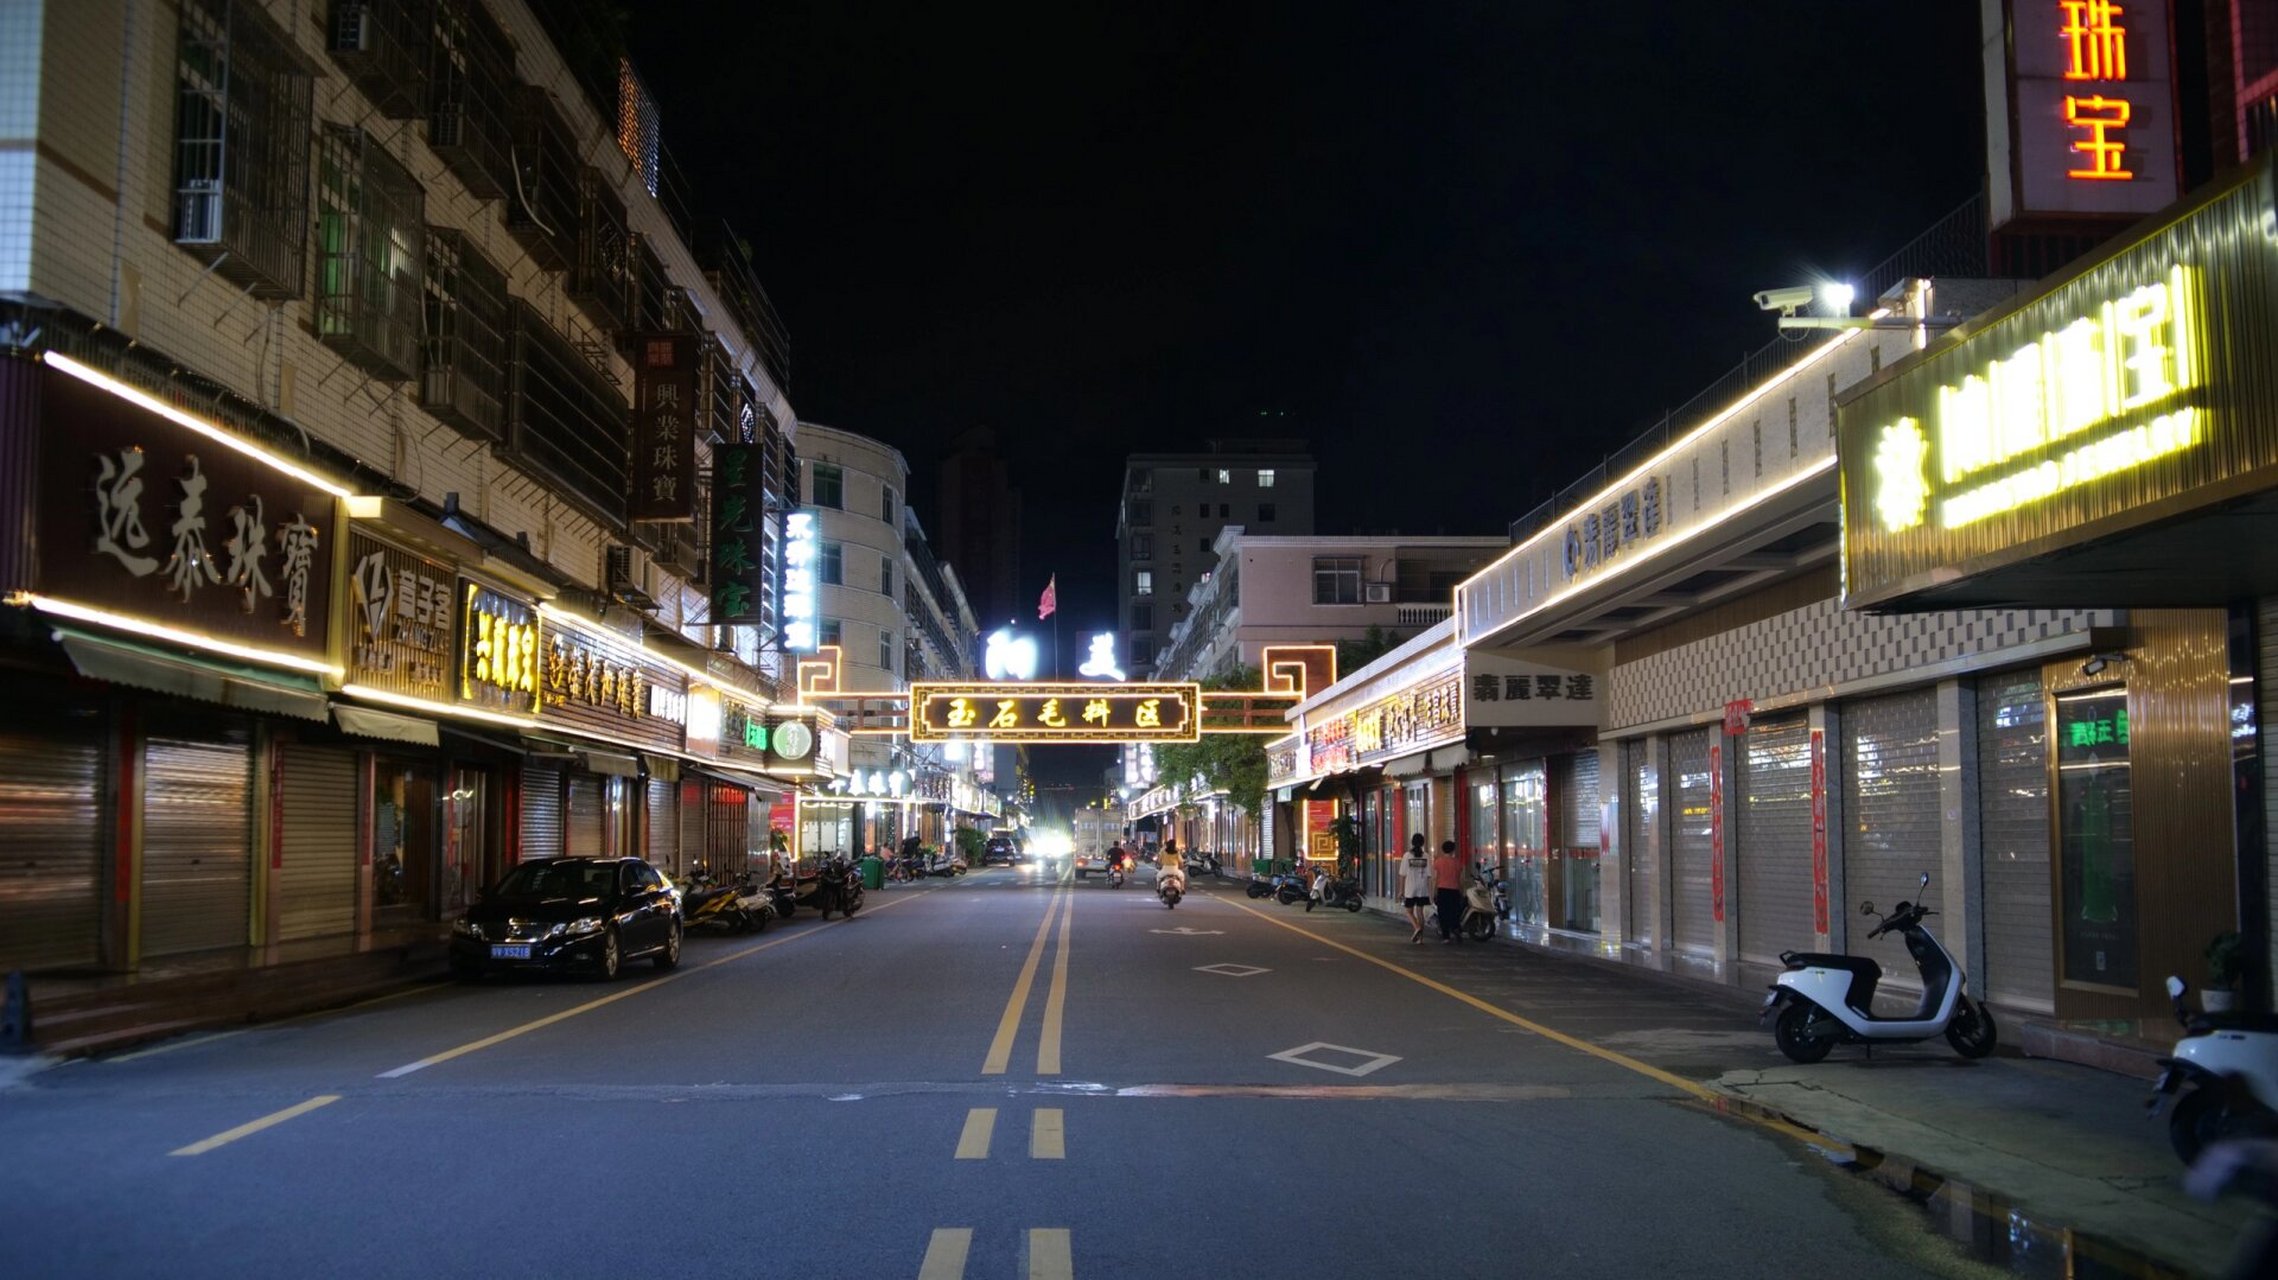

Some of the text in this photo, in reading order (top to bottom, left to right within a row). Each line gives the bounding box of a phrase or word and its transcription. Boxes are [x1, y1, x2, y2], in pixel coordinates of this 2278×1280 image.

[2057, 0, 2133, 180] 珠宝
[652, 383, 680, 503] 興業珠寶
[946, 697, 1161, 728] 玉石毛料区
